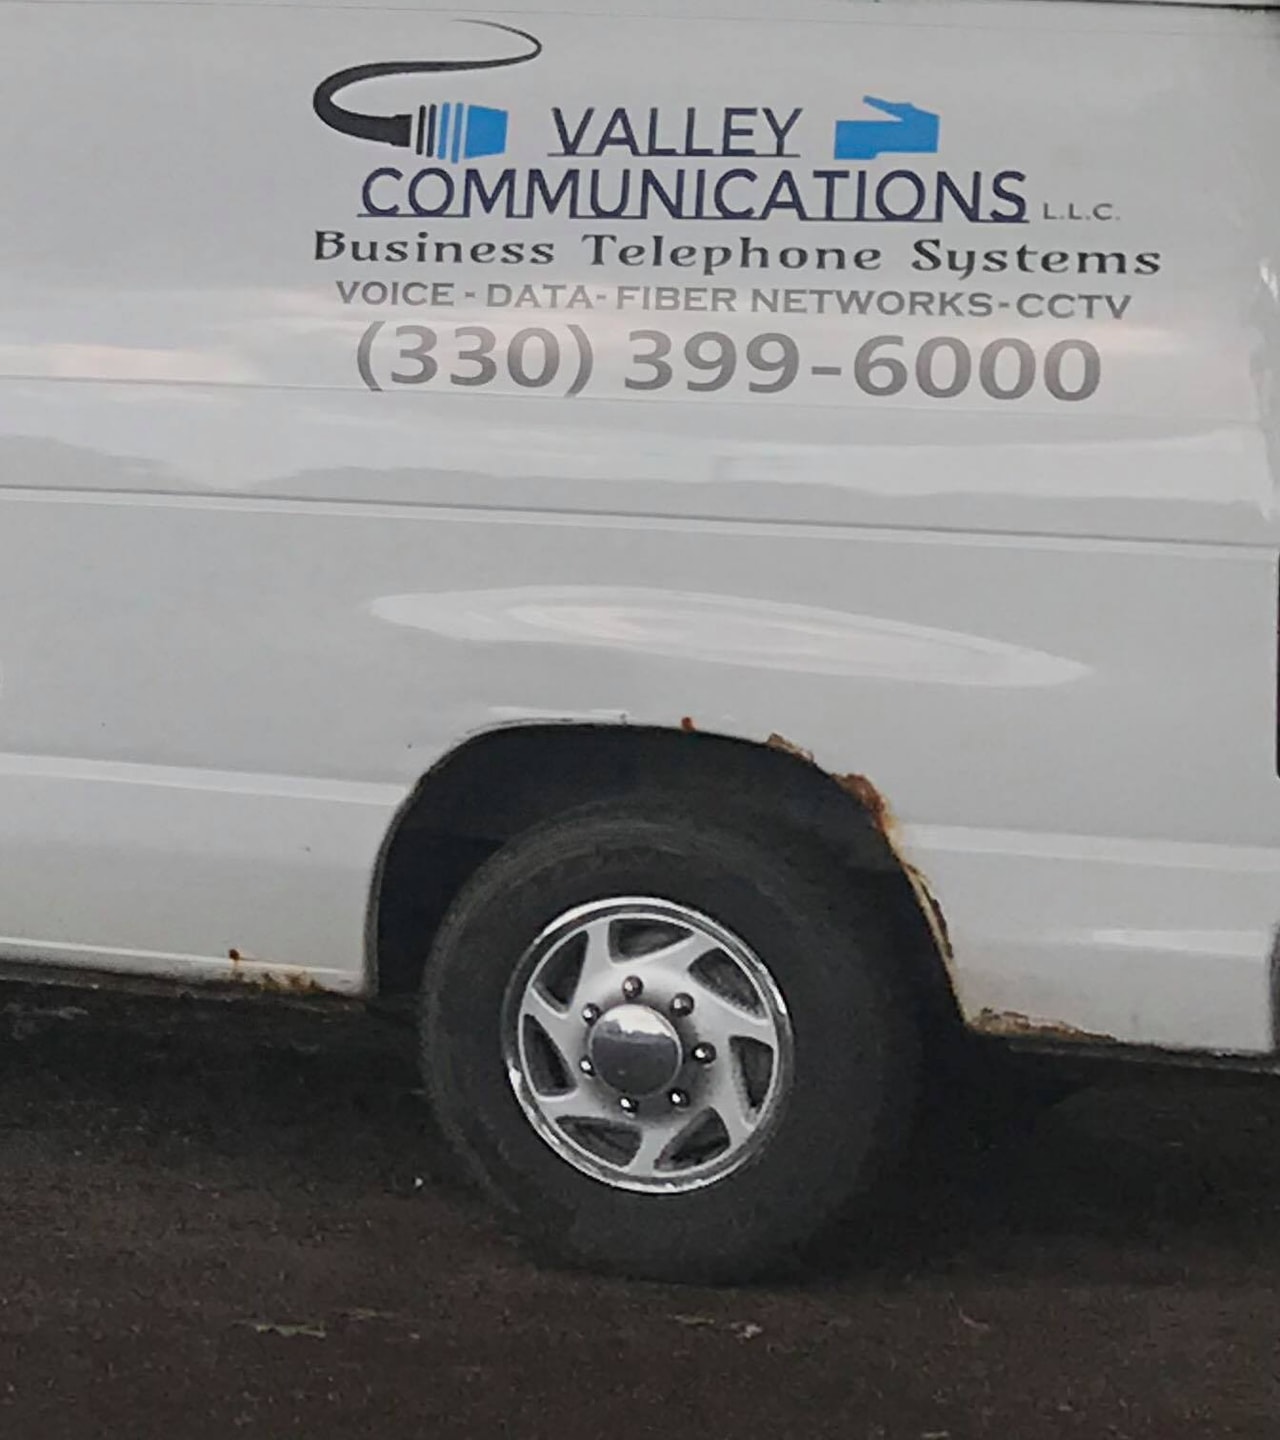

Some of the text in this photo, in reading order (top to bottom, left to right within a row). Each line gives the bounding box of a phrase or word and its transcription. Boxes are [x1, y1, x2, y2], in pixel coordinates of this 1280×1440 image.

[548, 106, 803, 157] VALLEY
[358, 166, 1121, 223] COMMUNICATIONS L.L.C.
[314, 229, 1162, 280] Business Telephone Systems
[335, 280, 456, 307] VOICE
[356, 320, 1102, 403] (330) 399-6000
